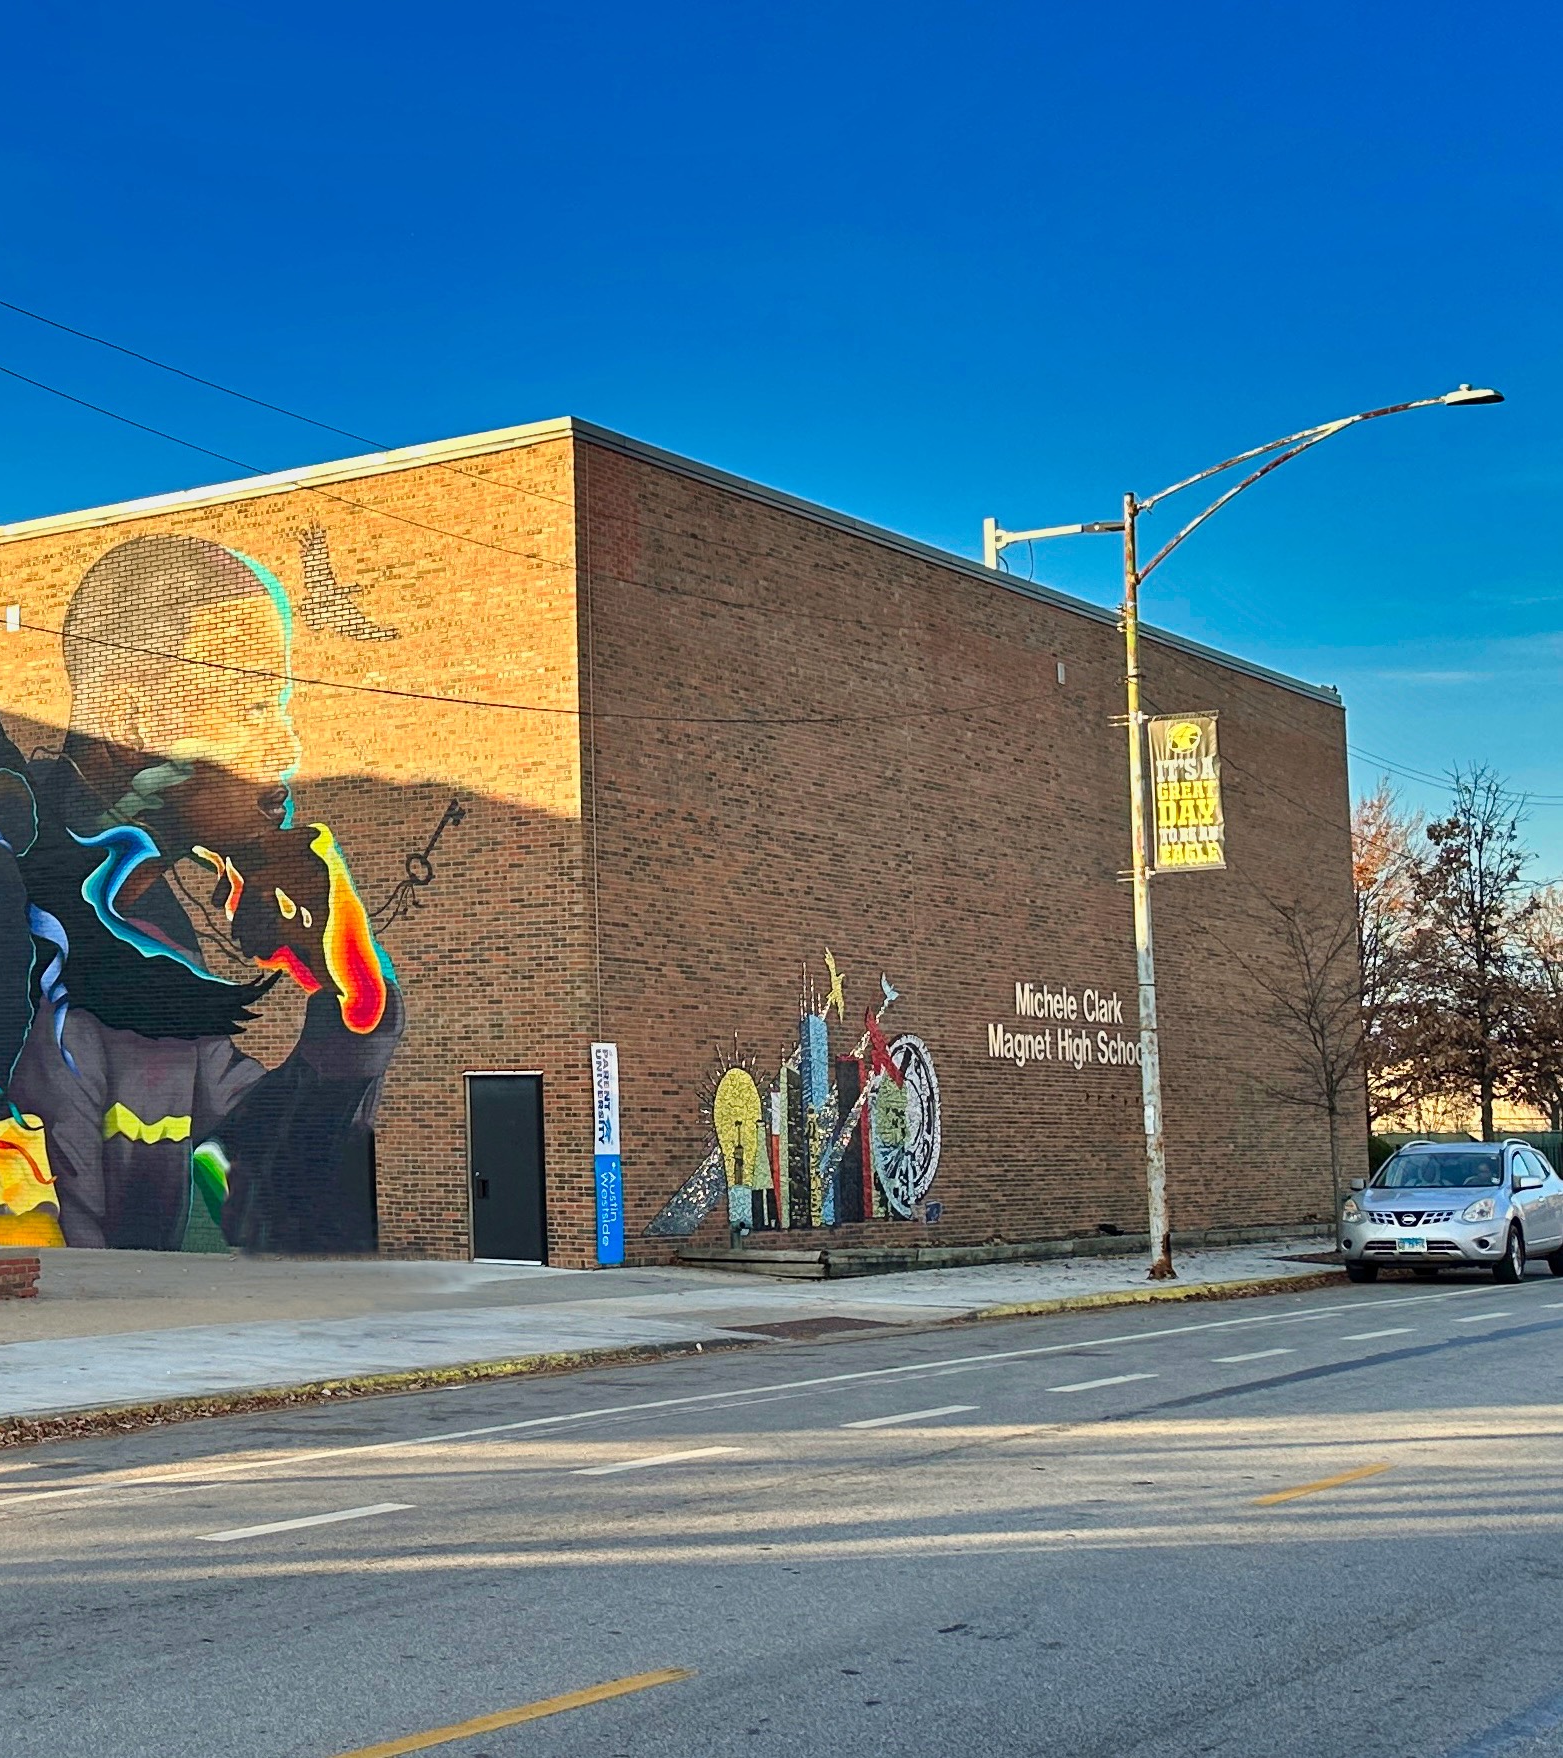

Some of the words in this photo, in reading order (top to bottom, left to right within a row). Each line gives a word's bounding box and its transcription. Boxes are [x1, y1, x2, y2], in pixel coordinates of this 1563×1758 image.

[1156, 758, 1198, 782] IT'S
[1201, 755, 1216, 780] A
[1157, 780, 1217, 800] GREAT
[1158, 798, 1218, 828] DAY
[1159, 827, 1177, 843] TO
[1159, 841, 1219, 866] EAGLE
[1015, 982, 1077, 1020] Michele
[1083, 988, 1123, 1023] Clark
[988, 1023, 1052, 1067] Magnet
[1057, 1028, 1092, 1070] High
[1097, 1030, 1142, 1066] Schoo
[595, 1049, 605, 1145] UNIVERSITY
[602, 1049, 611, 1111] PARENT
[600, 1172, 610, 1246] Westside
[608, 1171, 618, 1222] Austin
